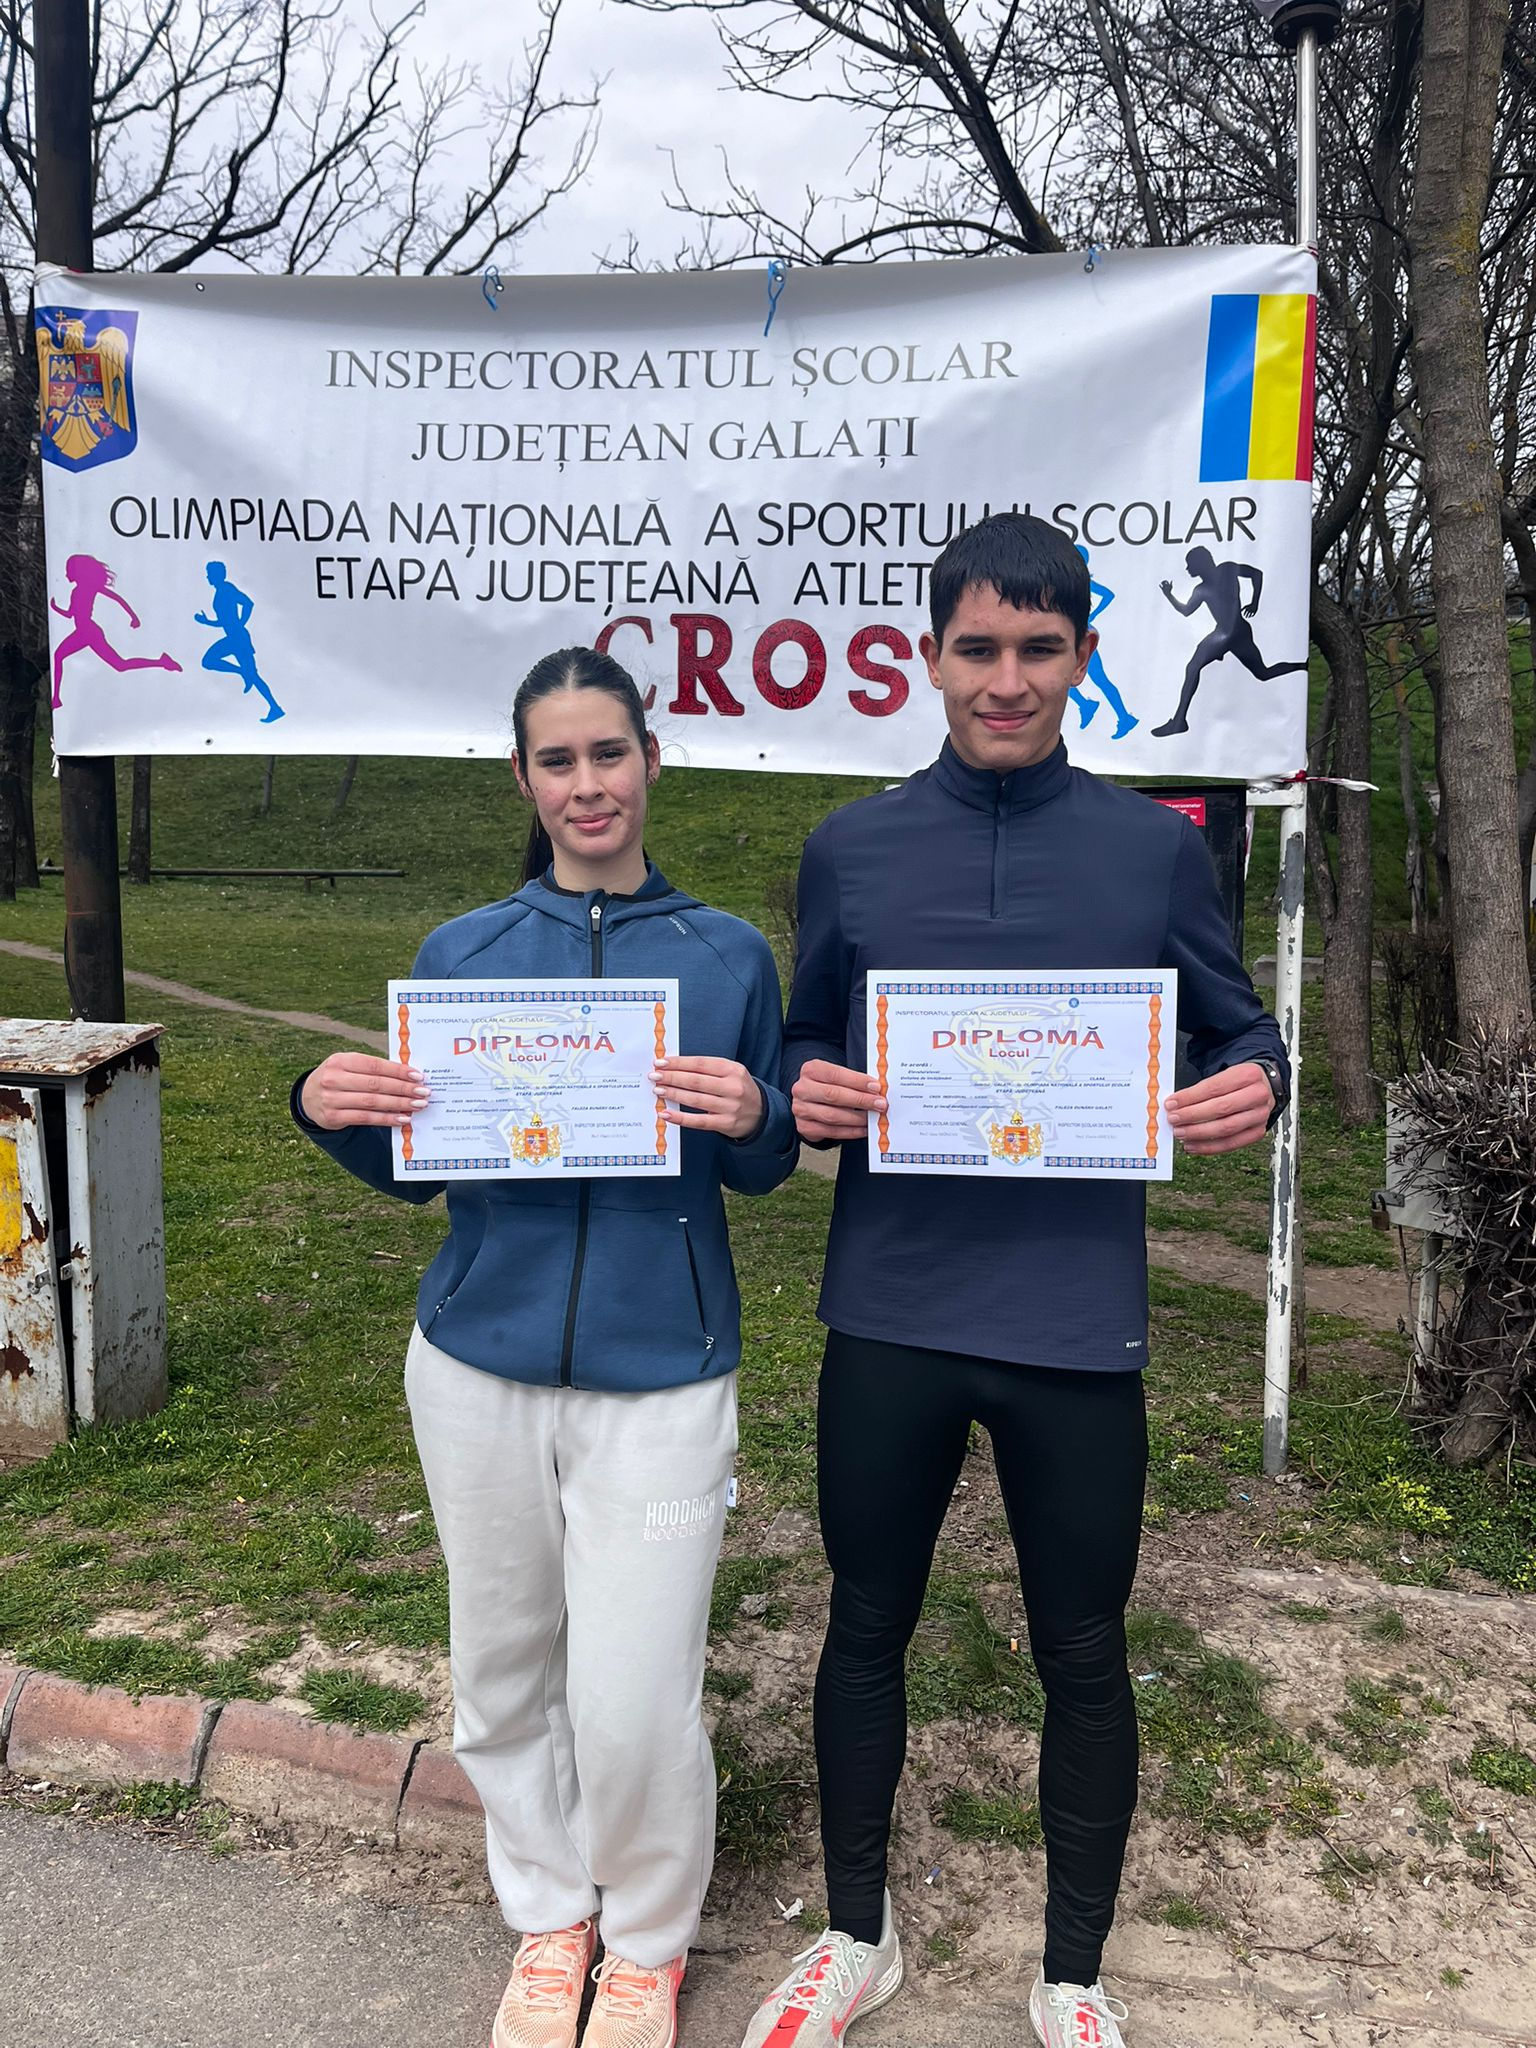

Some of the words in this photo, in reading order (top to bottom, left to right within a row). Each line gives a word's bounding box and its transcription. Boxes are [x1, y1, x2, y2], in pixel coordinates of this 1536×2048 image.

[325, 348, 774, 391] INSPECTORATUL
[791, 340, 1018, 398] ȘCOLAR
[411, 422, 692, 471] JUDEȚEAN
[708, 416, 920, 468] GALAȚI
[110, 495, 370, 543] OLIMPIADA
[389, 498, 672, 559] NAȚIONALĂ
[704, 502, 740, 547] A
[757, 501, 1032, 548] SPORTU
[316, 557, 460, 602] ETAPA
[476, 555, 760, 617] JUDEȚEANĂ
[453, 1031, 616, 1056] DIPLOMĂ
[932, 1026, 1105, 1050] DIPLOMĂ
[989, 1048, 1030, 1058] Locul
[508, 1052, 547, 1062] Locul
[646, 1490, 716, 1527] HOODRICH
